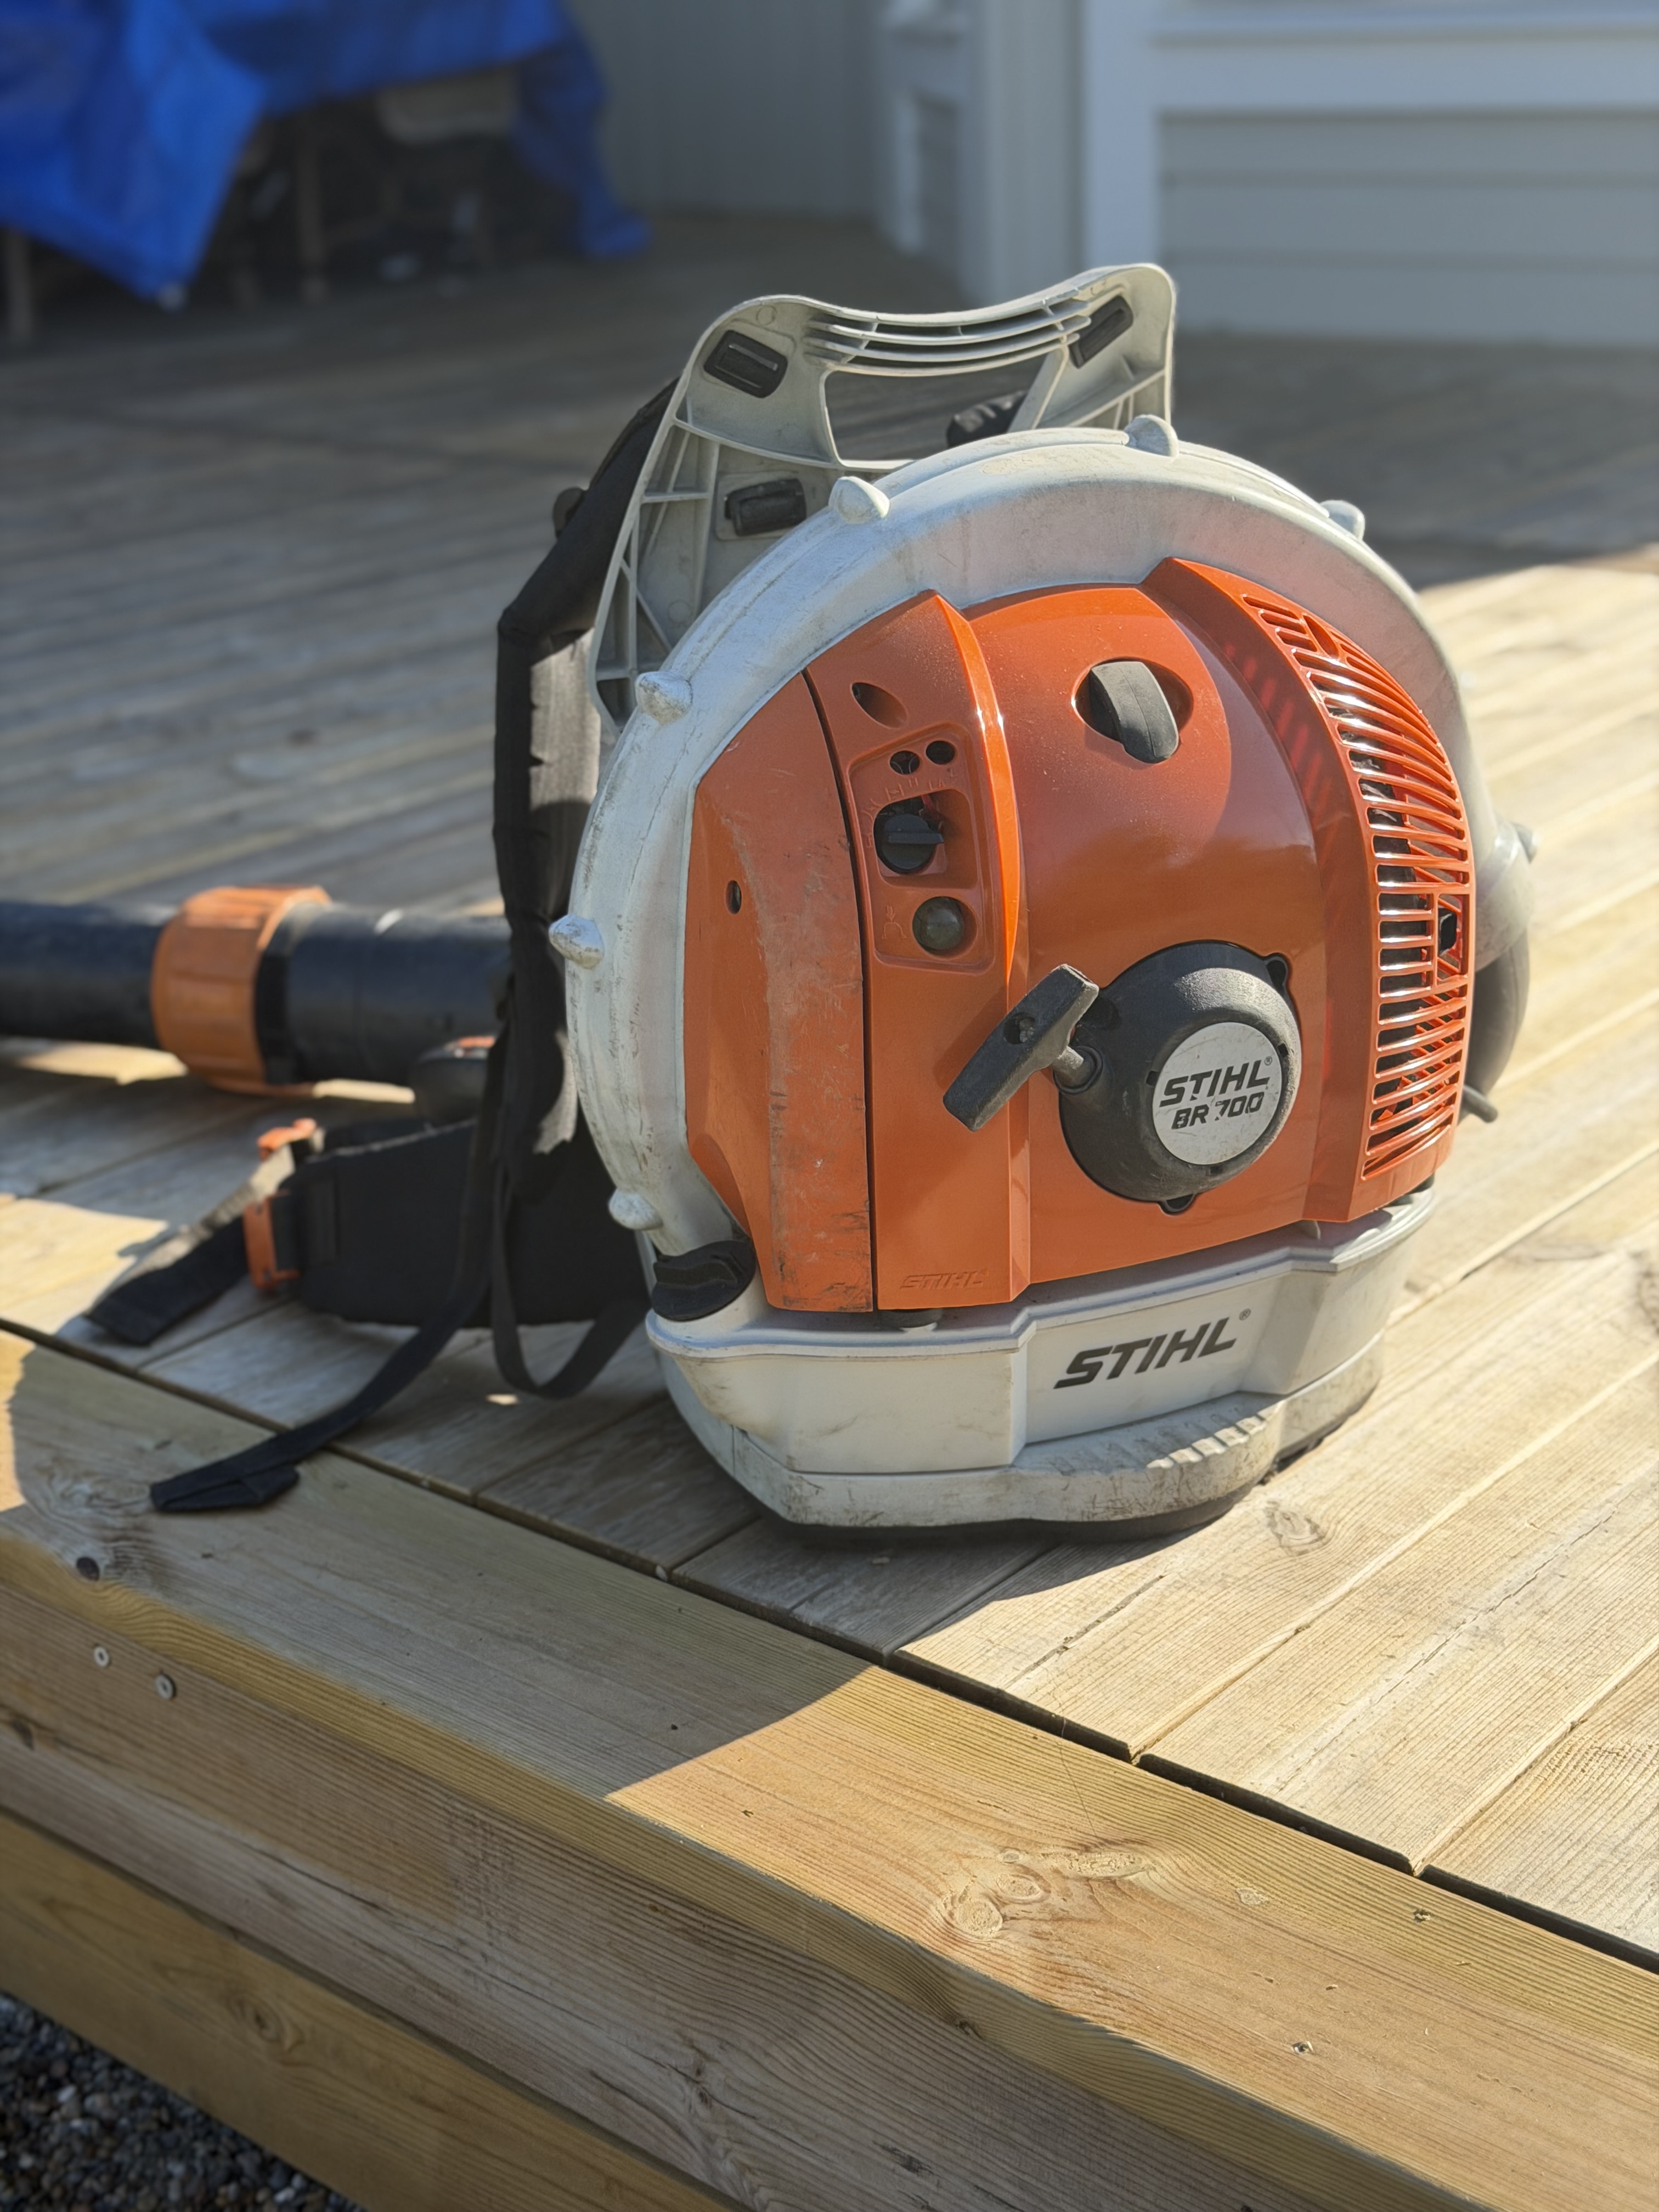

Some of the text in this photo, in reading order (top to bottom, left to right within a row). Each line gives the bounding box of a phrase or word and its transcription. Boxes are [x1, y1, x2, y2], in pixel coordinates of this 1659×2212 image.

[1171, 1092, 1265, 1130] BR 700
[899, 1271, 984, 1290] STIHL
